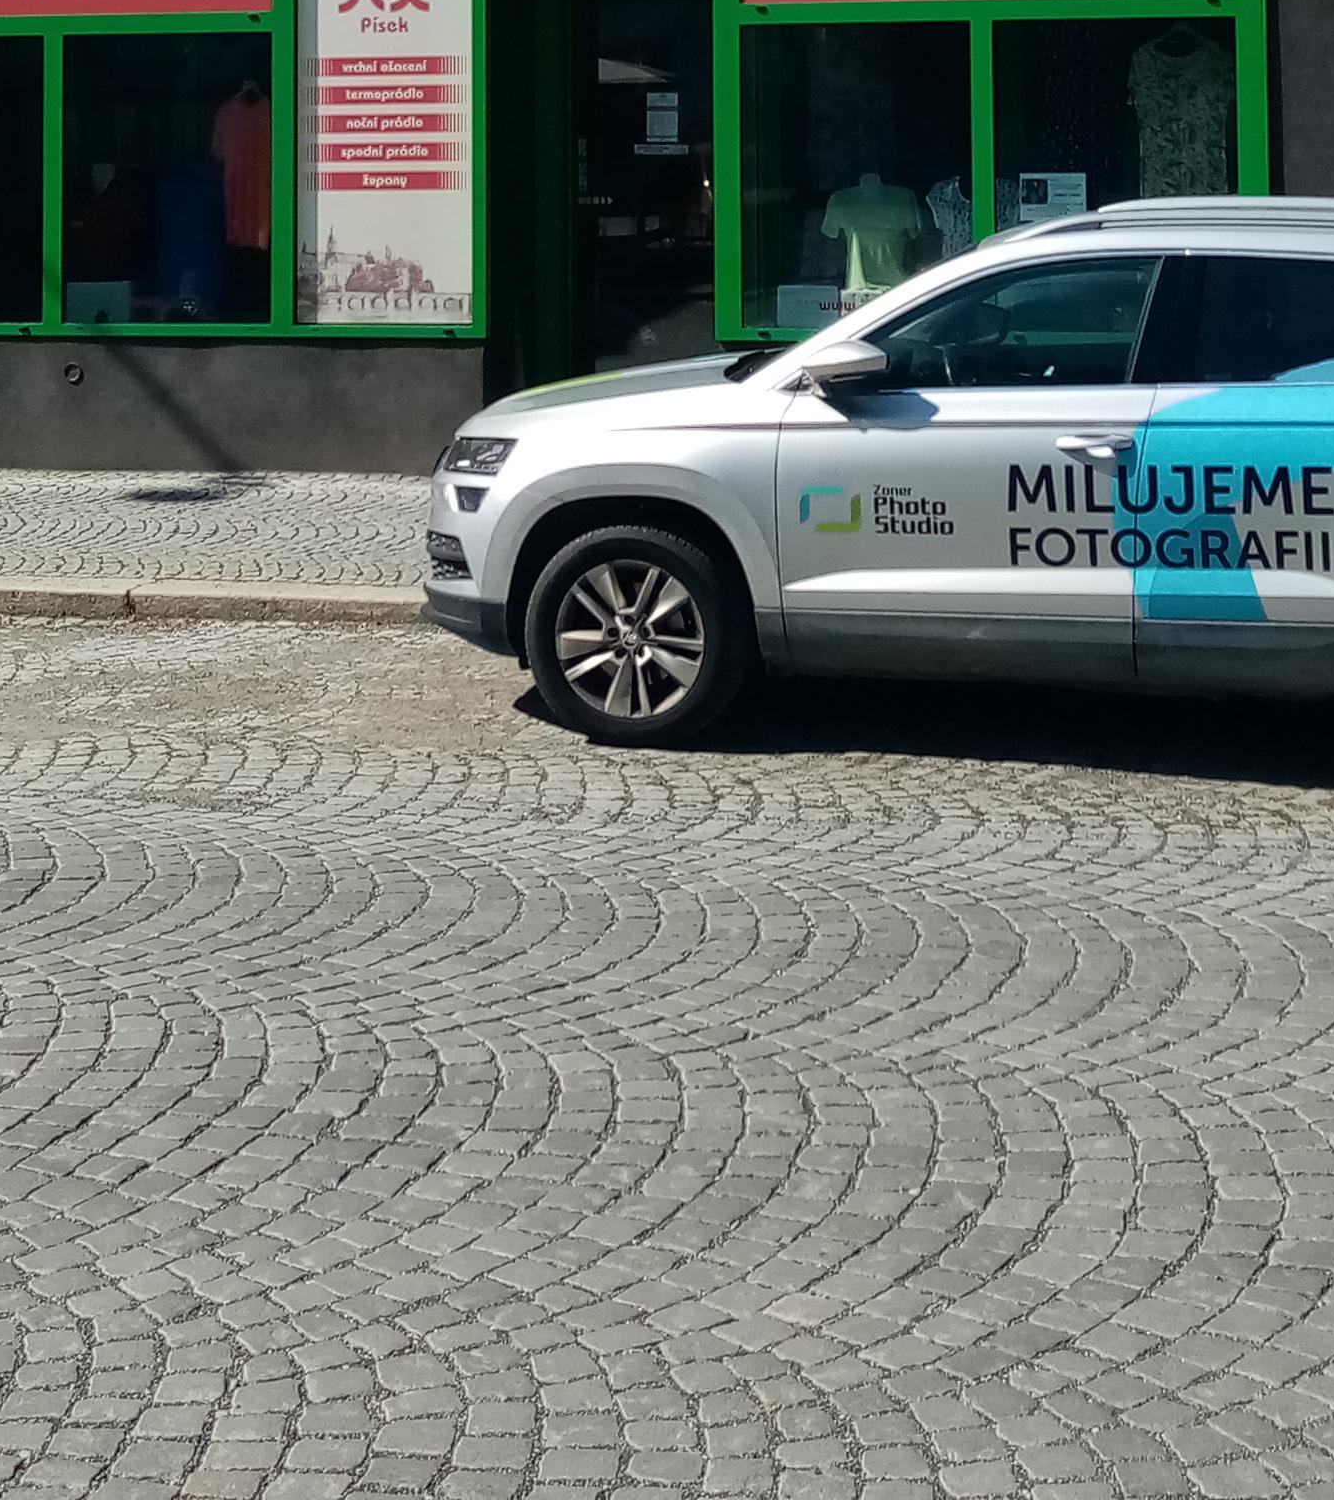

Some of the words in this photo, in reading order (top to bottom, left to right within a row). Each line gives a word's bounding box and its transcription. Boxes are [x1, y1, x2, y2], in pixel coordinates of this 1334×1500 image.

[361, 17, 409, 33] Písek
[342, 60, 377, 73] vrchní
[346, 89, 424, 102] termoprádlo
[346, 117, 378, 129] noční
[381, 116, 423, 131] prádlo
[341, 146, 383, 160] spodní
[386, 145, 428, 160] prádlo
[362, 174, 407, 188] župany
[873, 484, 912, 497] Zoner
[1008, 464, 1334, 516] MILUJEME
[873, 497, 947, 516] Photo
[874, 515, 955, 536] Studio
